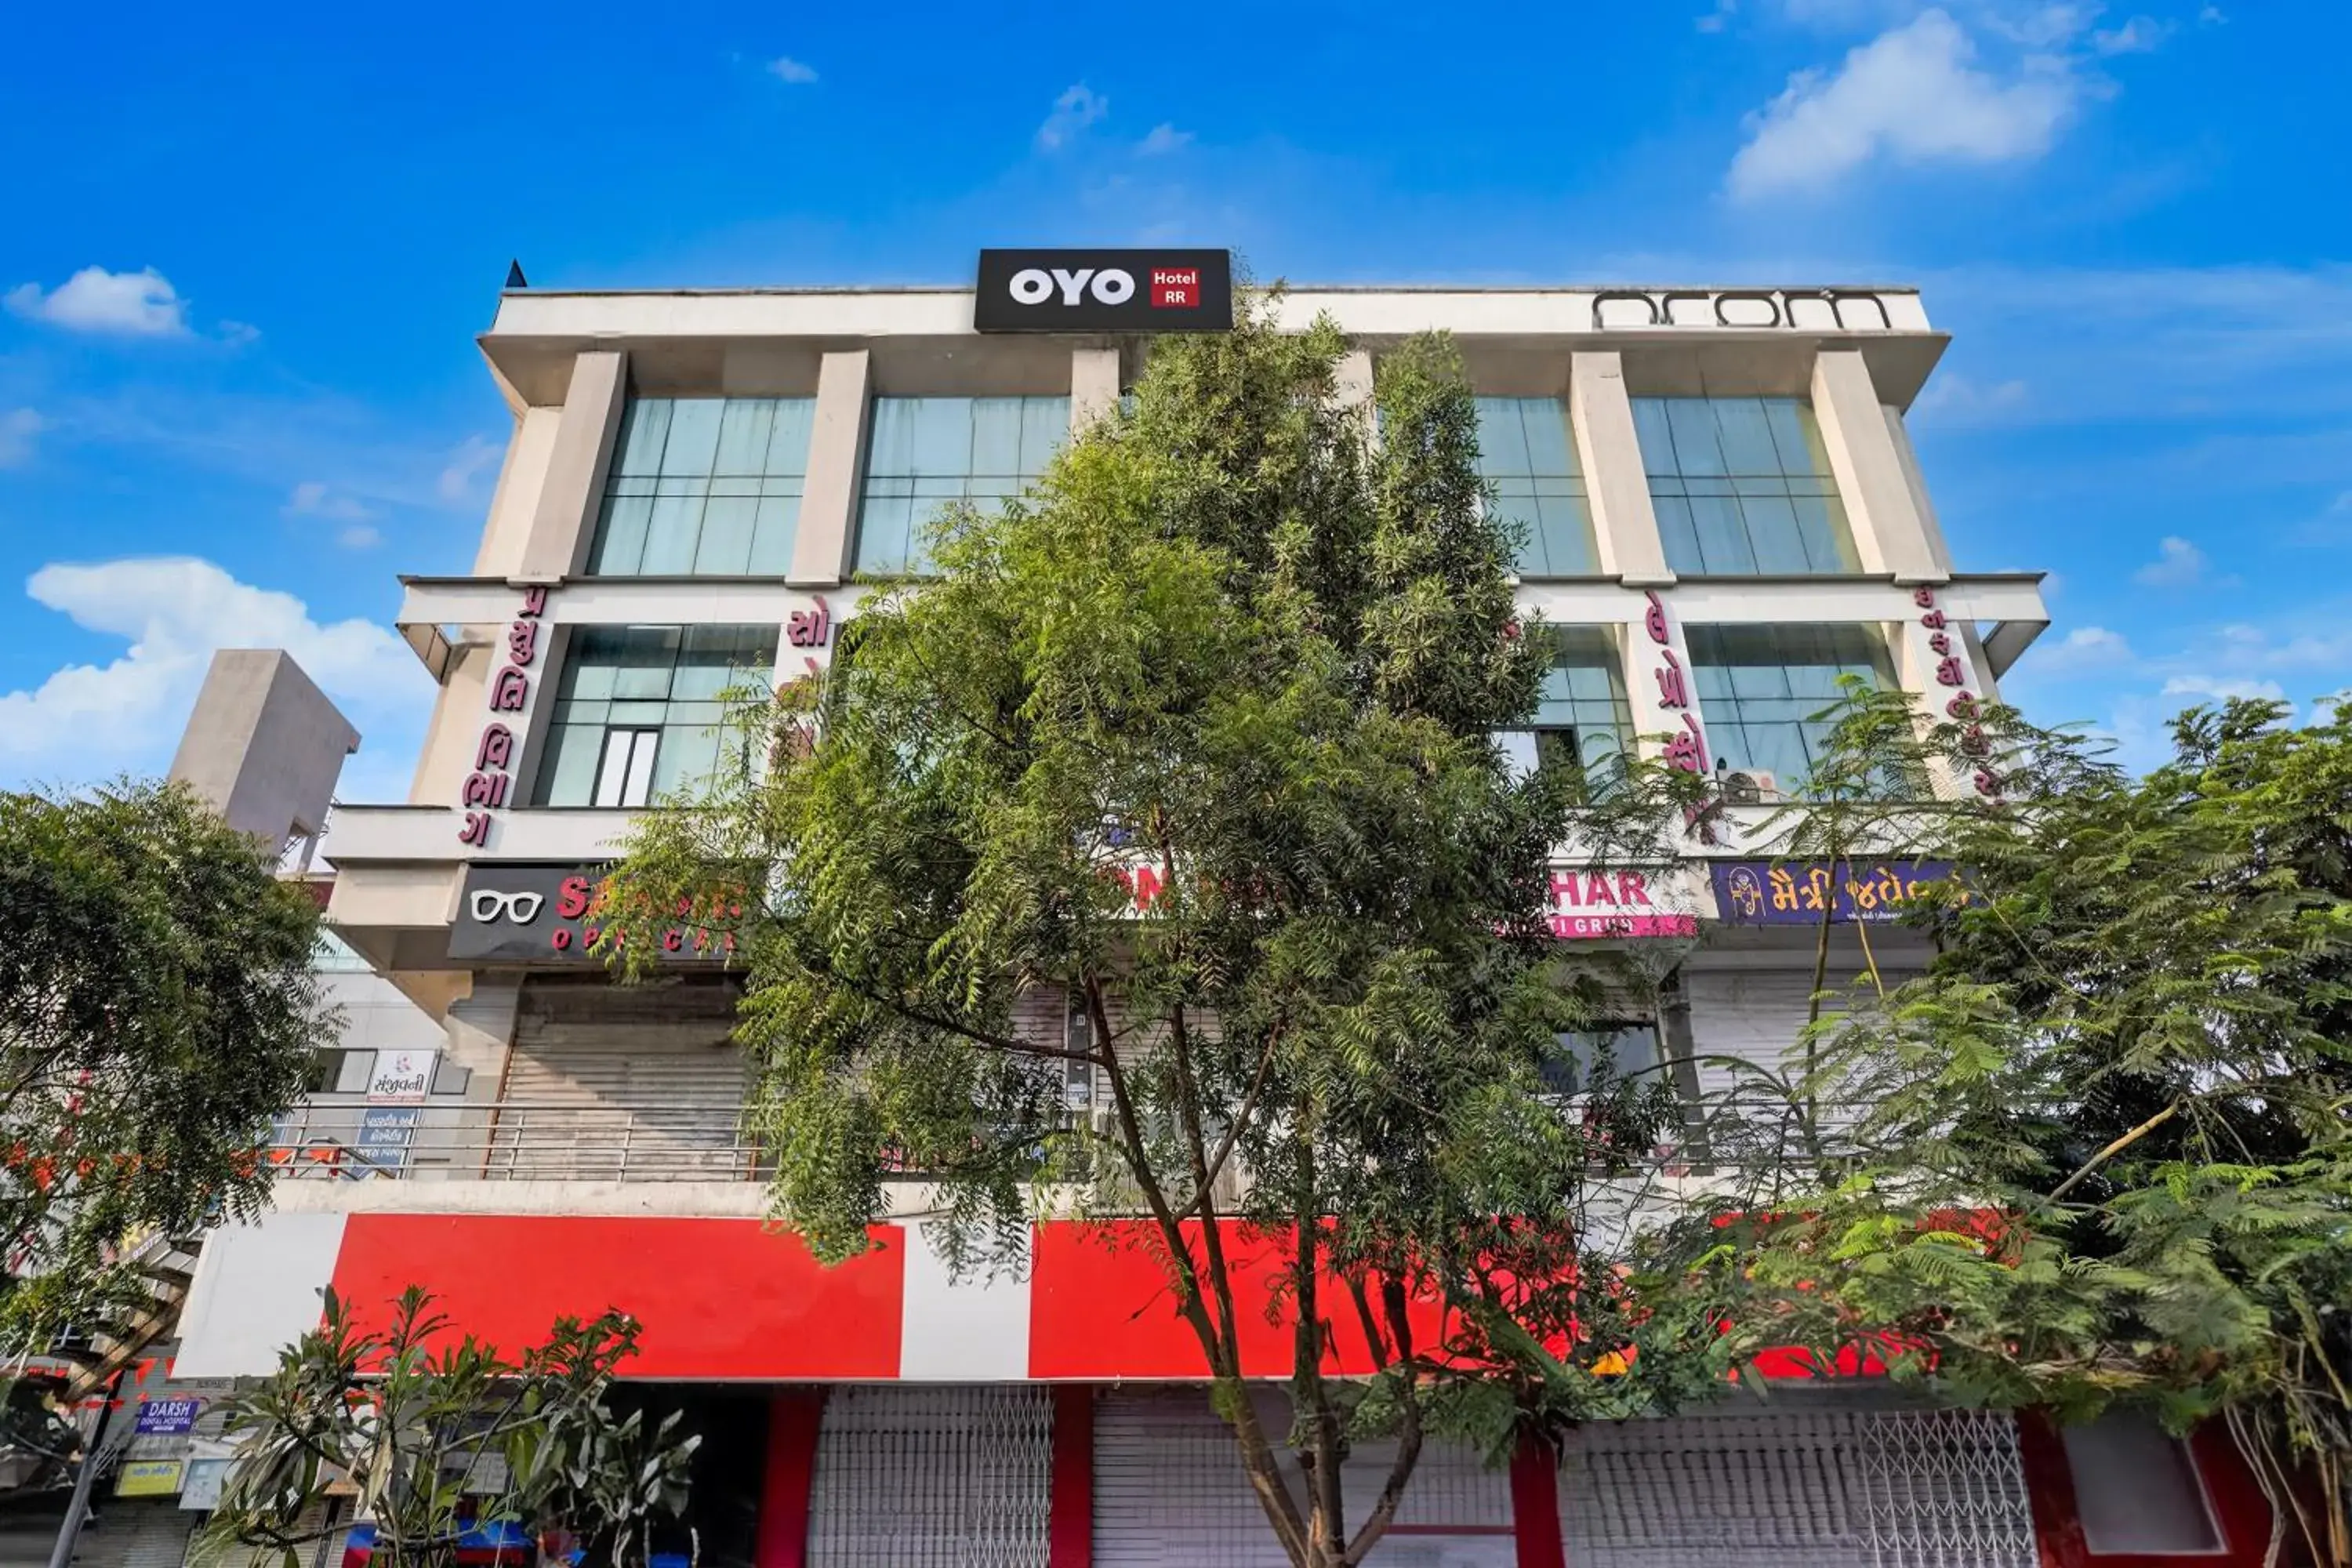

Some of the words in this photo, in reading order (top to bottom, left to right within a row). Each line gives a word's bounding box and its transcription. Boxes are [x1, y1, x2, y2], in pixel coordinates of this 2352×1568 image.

[1154, 271, 1196, 285] Hotel
[1009, 268, 1136, 307] OYO
[1165, 291, 1186, 303] RR
[148, 1403, 192, 1417] DARSH
